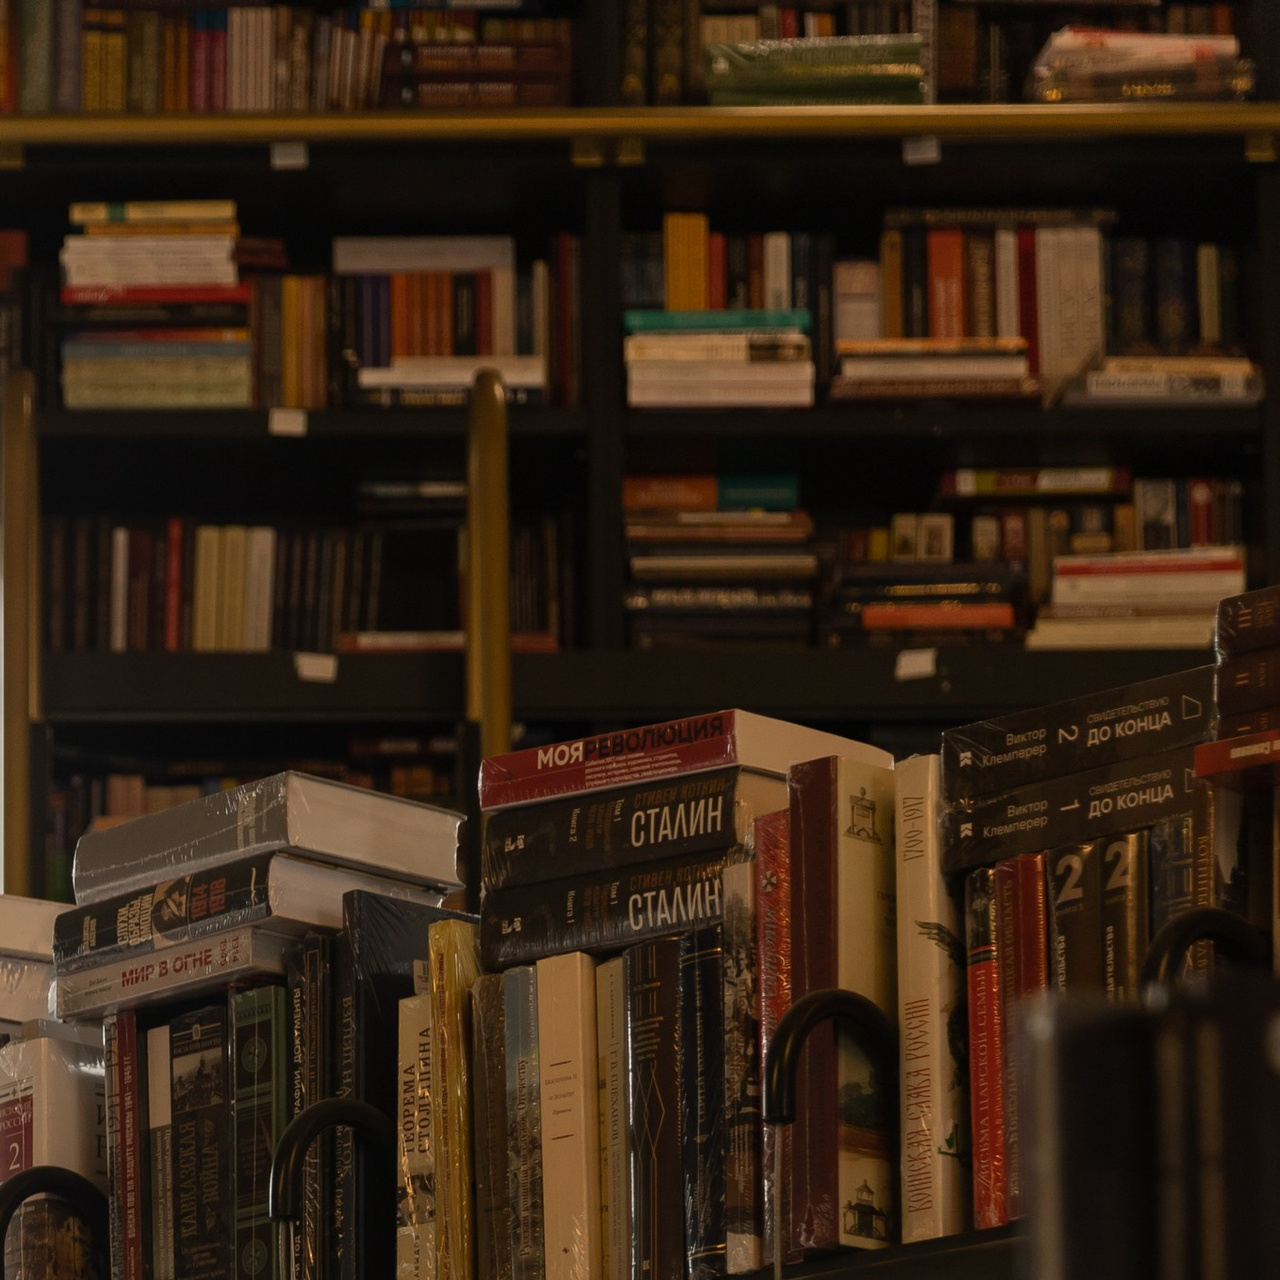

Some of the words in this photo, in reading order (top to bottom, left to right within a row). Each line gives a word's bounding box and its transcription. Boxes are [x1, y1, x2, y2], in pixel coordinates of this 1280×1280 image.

[1006, 728, 1046, 746] Виктор
[1058, 725, 1079, 744] 2
[1087, 726, 1111, 747] ДО
[1115, 712, 1172, 738] КОНЦА
[537, 741, 583, 769] МОЯ
[982, 744, 1047, 767] Клемперер
[1008, 800, 1048, 817] Виктор
[1089, 798, 1112, 819] ДО
[1117, 784, 1174, 810] КОНЦА
[631, 796, 723, 848] СТАЛИН
[983, 816, 1048, 838] Клемперер
[1056, 854, 1083, 903] 2
[628, 879, 720, 931] СТАЛИН
[122, 964, 154, 987] МИР
[159, 960, 168, 977] В
[173, 948, 212, 973] ОГНЕ
[402, 1064, 415, 1155] ТЕОРЕМА
[9, 1142, 20, 1170] 2
[199, 1142, 219, 1202] ВОЙНА
[181, 1120, 198, 1238] КАВКАЗСКАЯ
